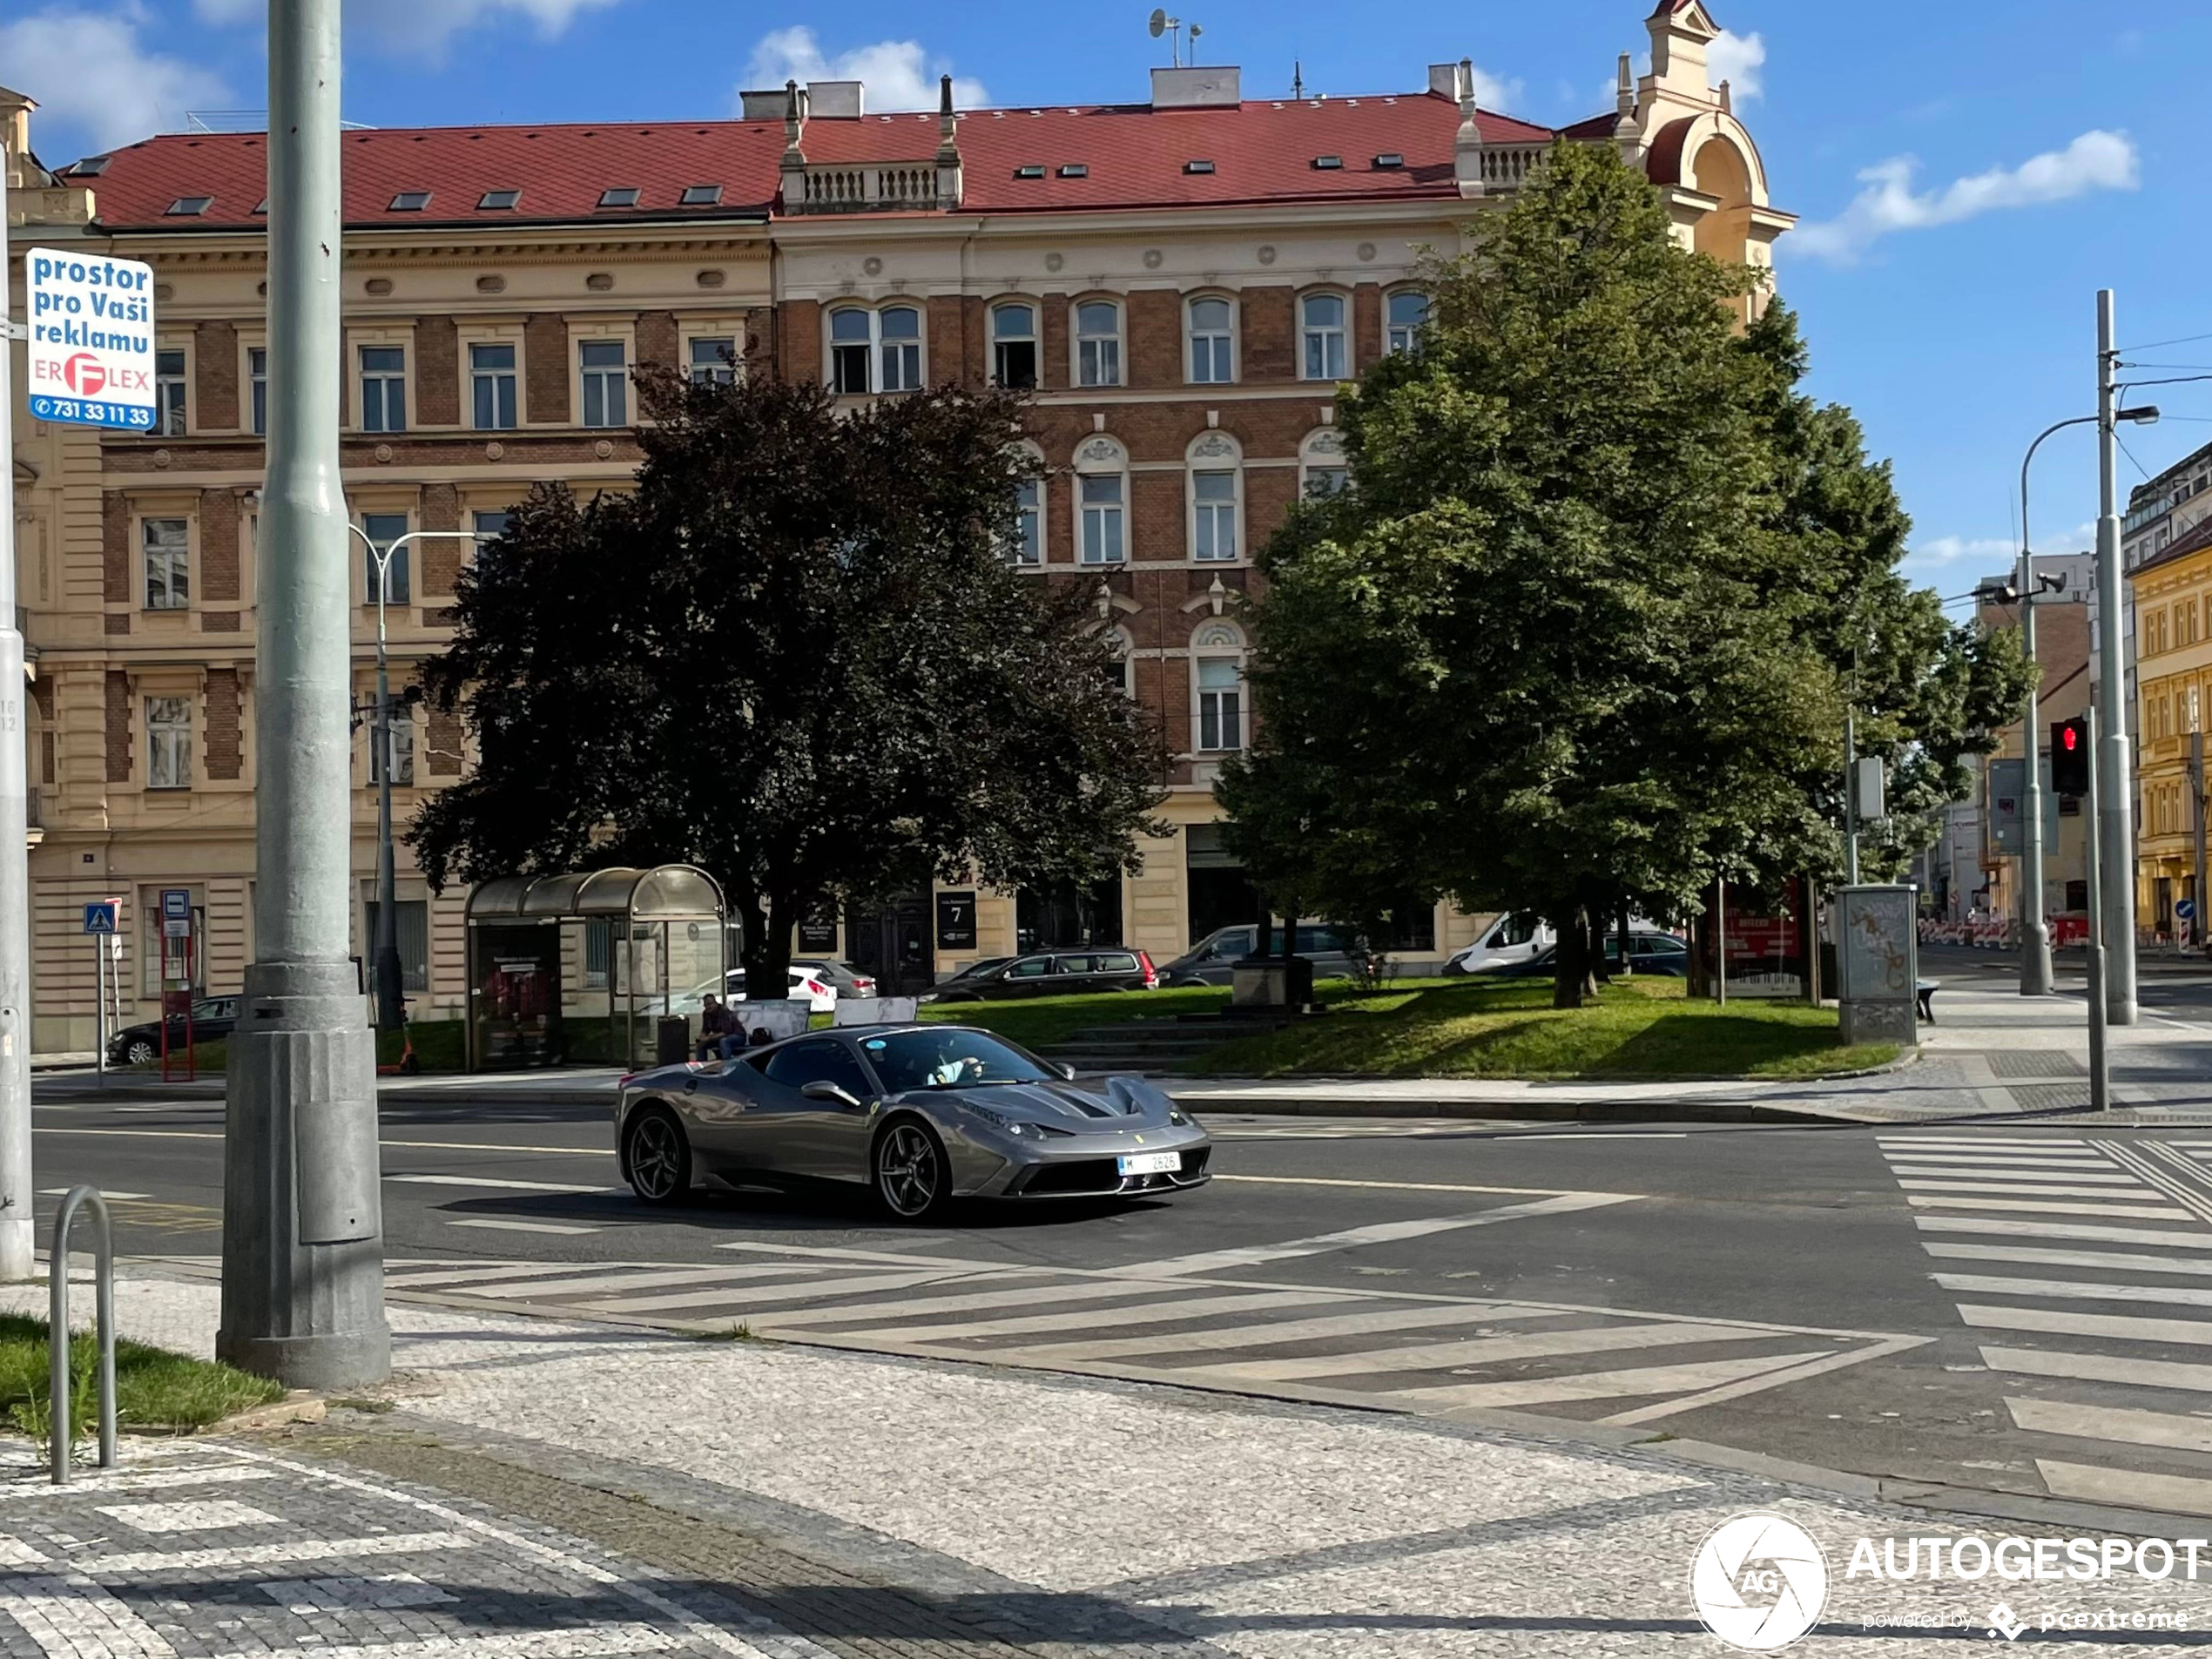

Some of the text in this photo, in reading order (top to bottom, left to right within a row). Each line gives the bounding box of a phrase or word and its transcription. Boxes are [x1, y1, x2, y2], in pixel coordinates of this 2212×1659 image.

[34, 257, 148, 291] prostor
[34, 291, 148, 322] pro Vaši
[35, 319, 148, 354] reklamu
[53, 400, 149, 425] 731 33 11 33
[951, 907, 961, 923] 7
